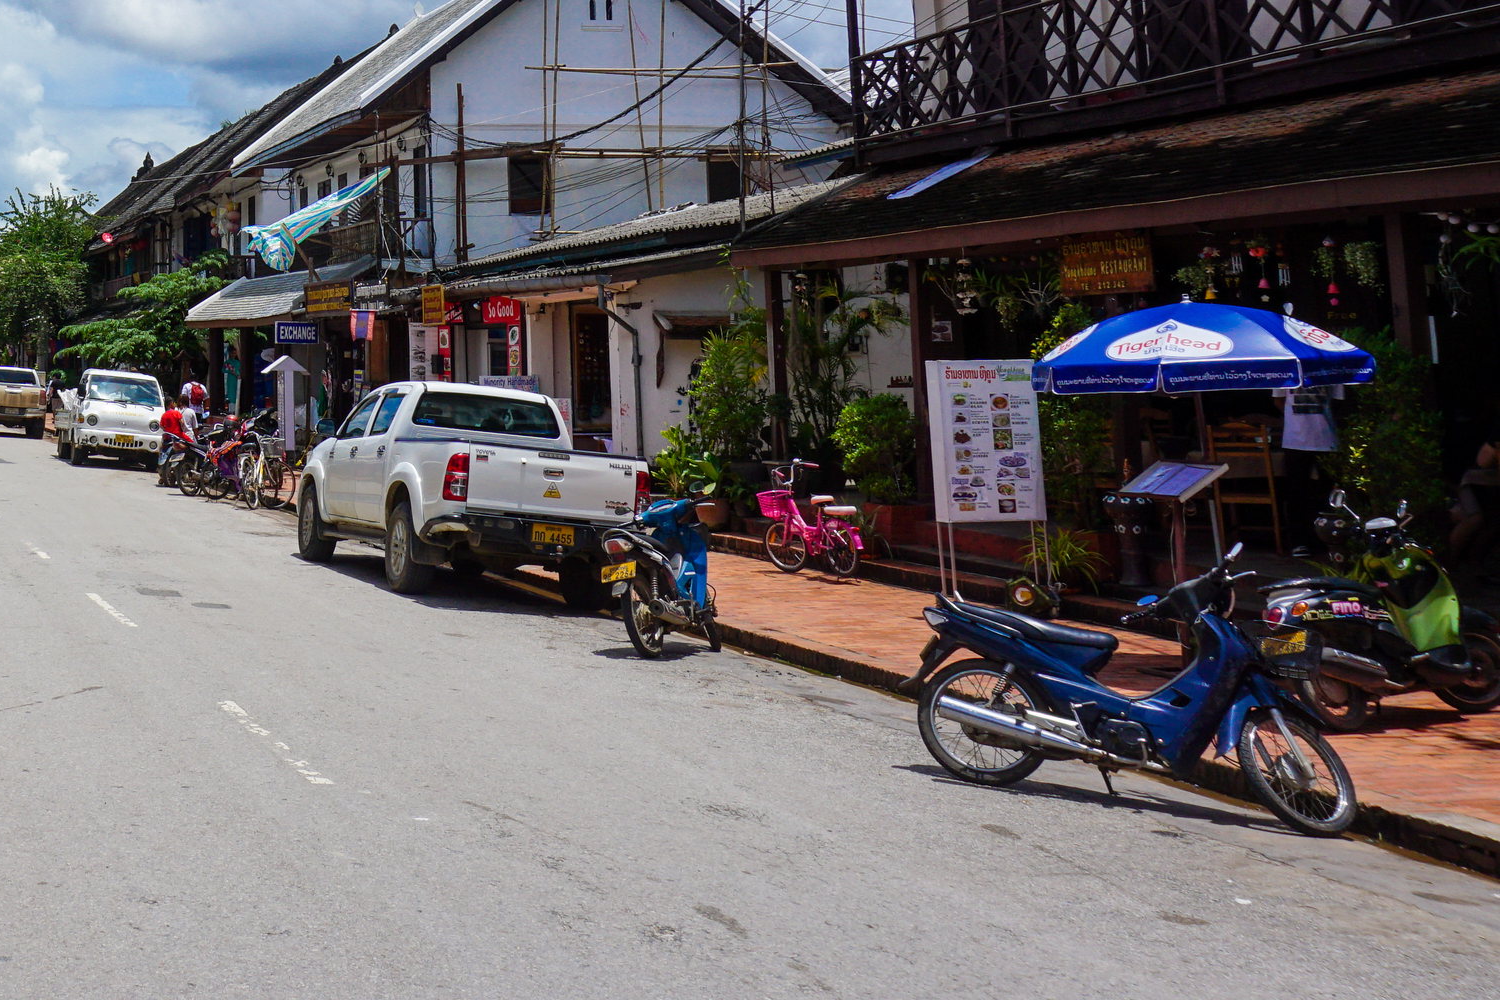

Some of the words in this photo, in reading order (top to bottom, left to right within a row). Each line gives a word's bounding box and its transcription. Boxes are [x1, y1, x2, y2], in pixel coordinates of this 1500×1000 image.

[1100, 256, 1148, 275] RESTAURANT
[488, 303, 496, 318] So
[496, 301, 514, 318] Good
[279, 325, 316, 341] EXCHANGE
[1113, 336, 1163, 355] Tiger
[1166, 333, 1222, 351] head
[483, 378, 505, 388] Minority
[507, 376, 536, 386] Handmade
[476, 448, 496, 456] TOYOTA
[609, 462, 632, 471] HILUX
[549, 533, 572, 545] 4455
